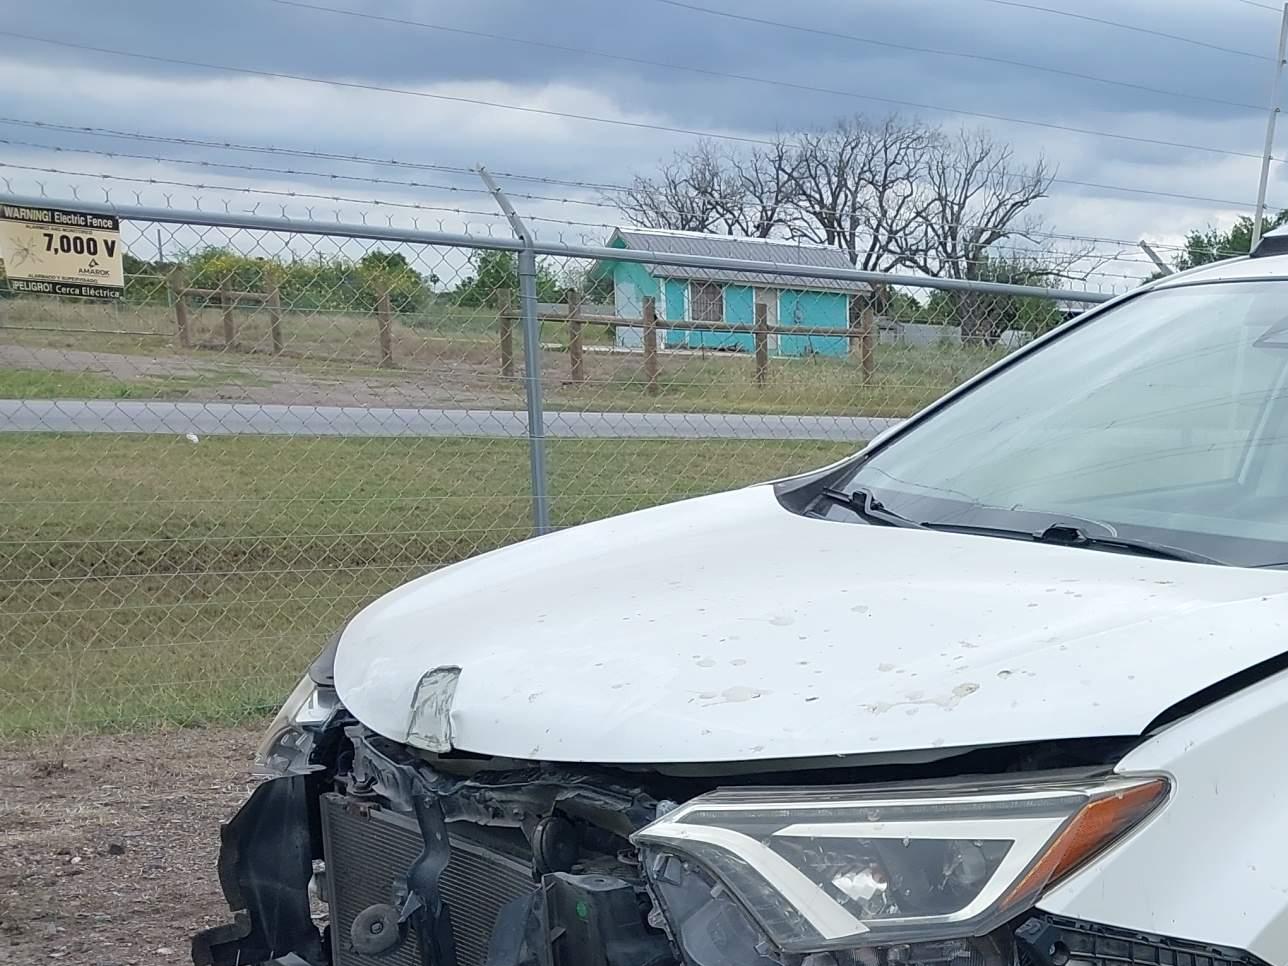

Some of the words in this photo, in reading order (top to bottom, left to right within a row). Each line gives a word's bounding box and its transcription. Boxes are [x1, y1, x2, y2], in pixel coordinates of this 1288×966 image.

[4, 206, 51, 222] WARNING!
[54, 211, 85, 225] Electric
[87, 215, 113, 228] Fence
[43, 233, 98, 256] 7,000
[102, 239, 116, 258] V
[56, 285, 80, 295] Cerca
[82, 286, 120, 298] Eléctrica
